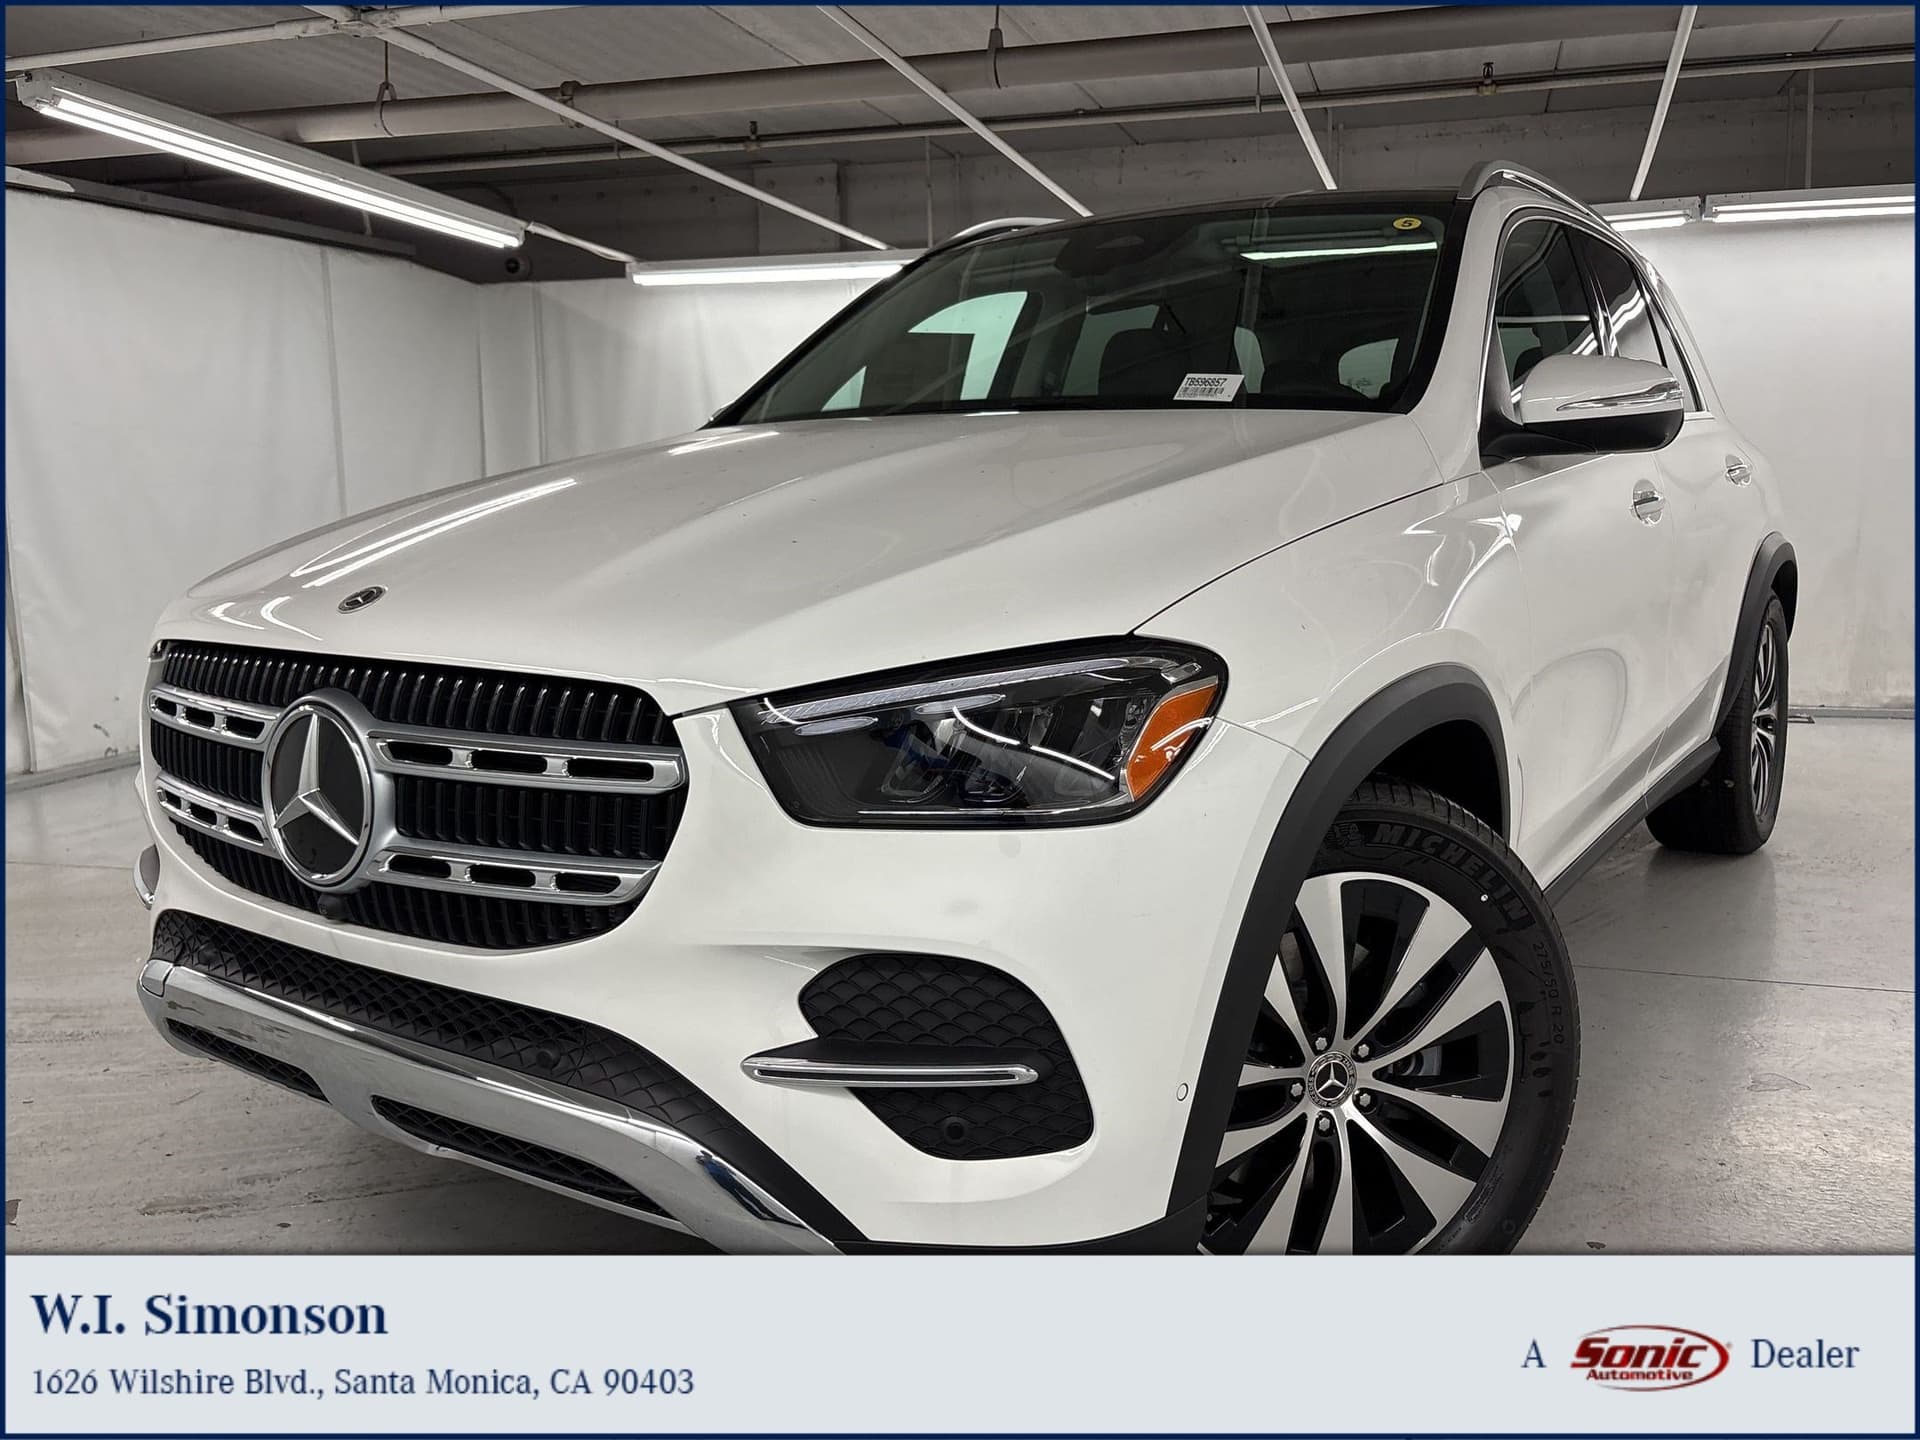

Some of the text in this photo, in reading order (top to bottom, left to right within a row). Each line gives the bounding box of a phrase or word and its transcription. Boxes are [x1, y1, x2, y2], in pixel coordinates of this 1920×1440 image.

[1373, 822, 1530, 926] MICHELIN
[1532, 942, 1565, 1045] 275/50 R 20
